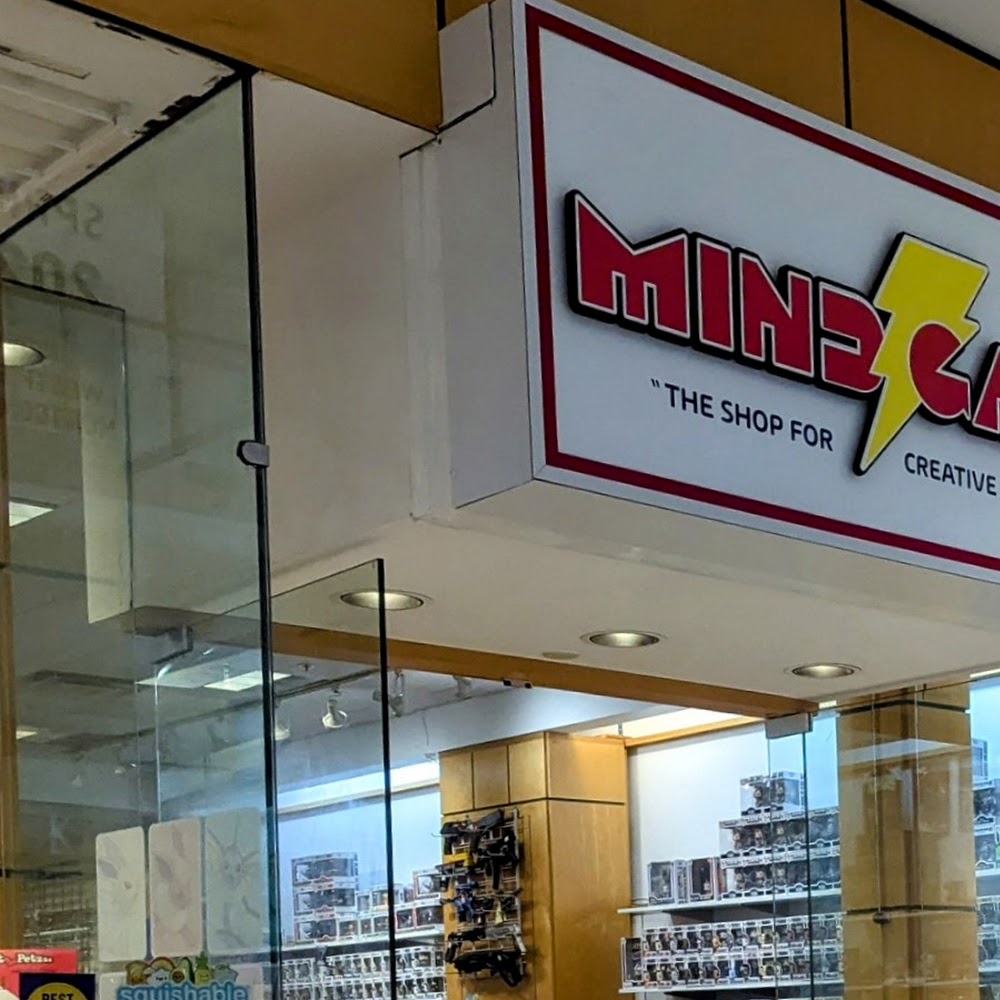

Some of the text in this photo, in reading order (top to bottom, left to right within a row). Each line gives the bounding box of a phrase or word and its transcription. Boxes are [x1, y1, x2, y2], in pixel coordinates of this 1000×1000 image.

[565, 189, 886, 398] MIND
[721, 400, 783, 434] SHOP
[789, 418, 834, 452] FOR
[904, 452, 998, 498] CREATIVE
